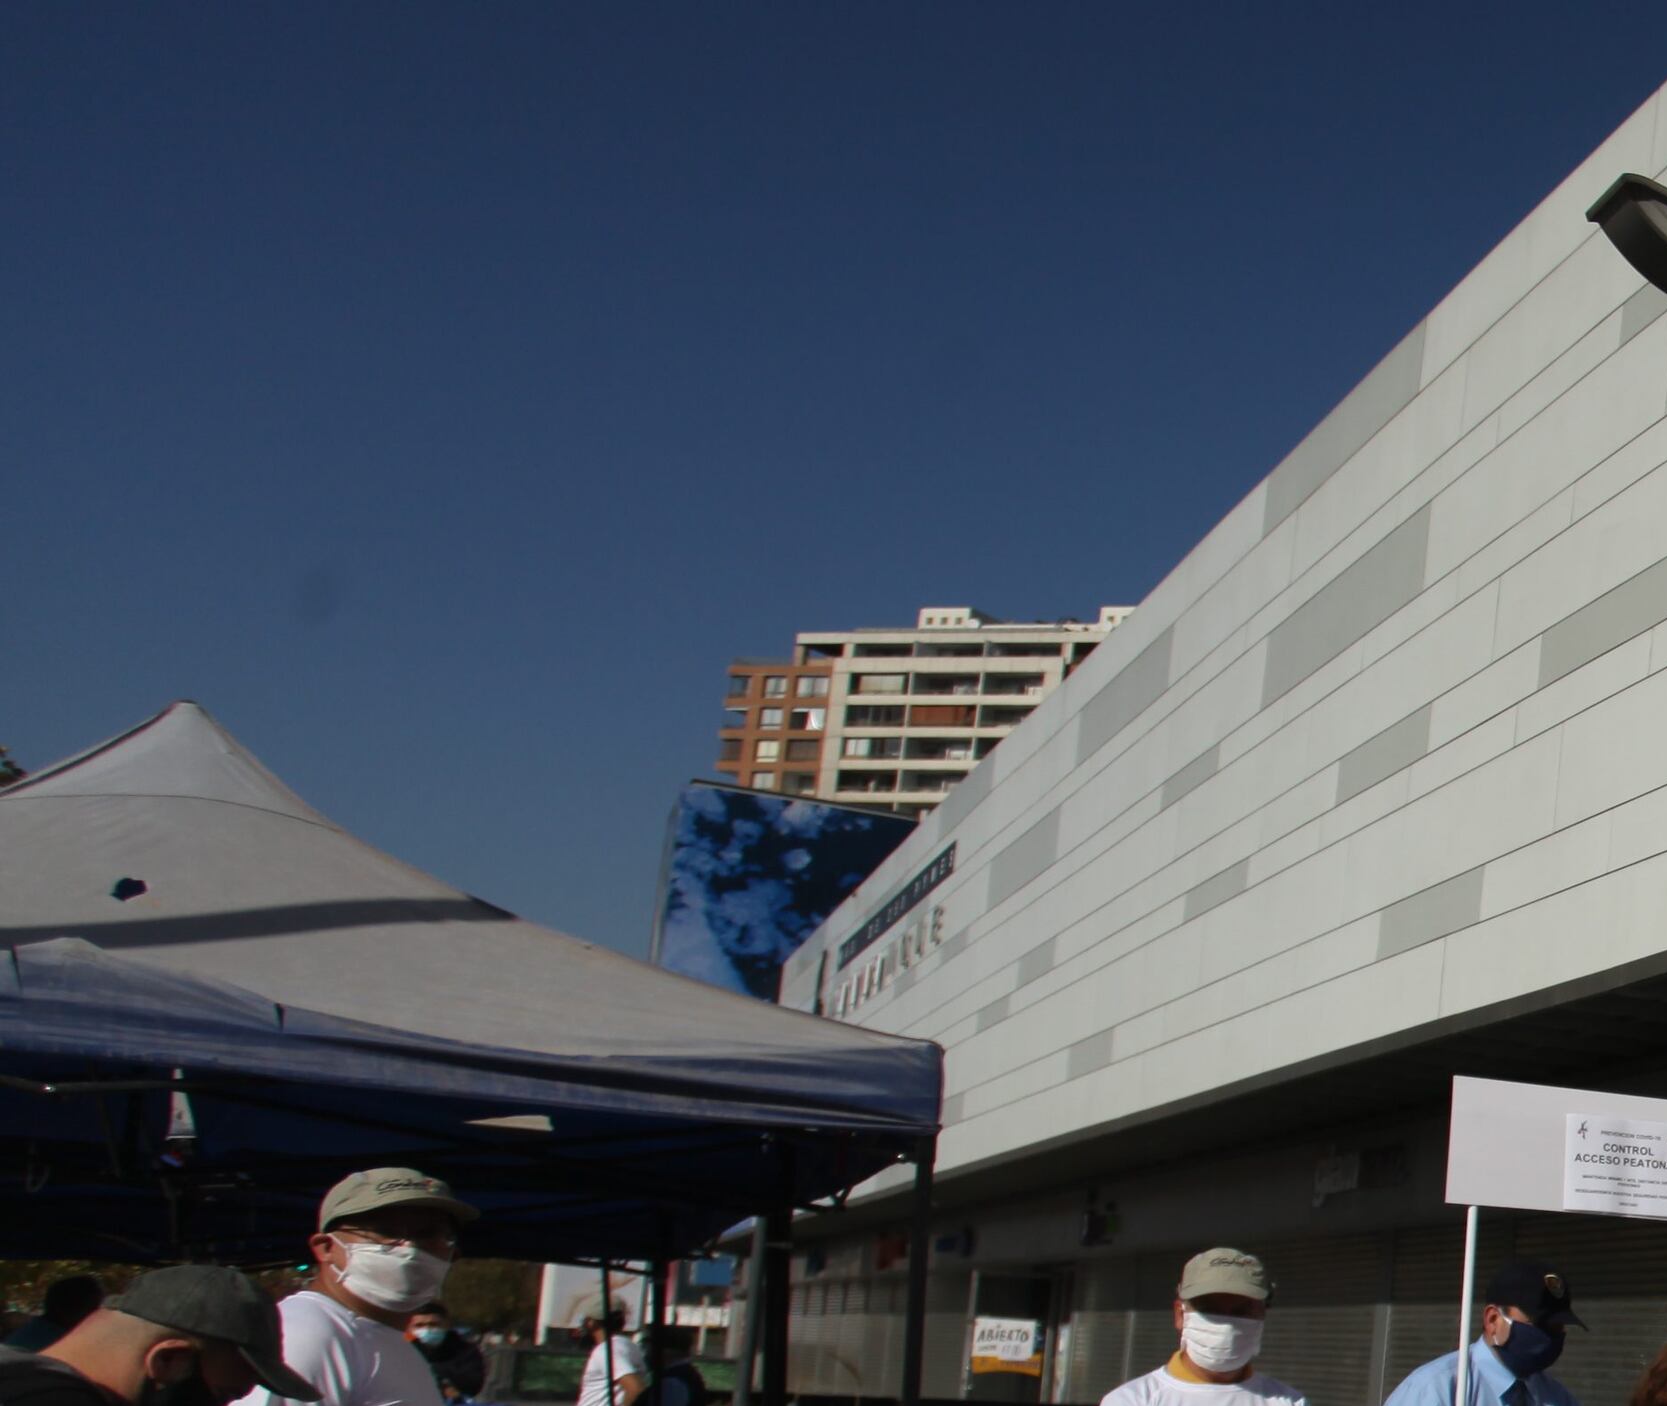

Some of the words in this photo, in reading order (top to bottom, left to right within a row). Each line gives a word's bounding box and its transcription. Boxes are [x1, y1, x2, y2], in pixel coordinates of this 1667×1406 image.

[1603, 1143, 1655, 1156] CONTROL
[1574, 1153, 1621, 1166] ACCESO
[977, 1324, 1029, 1343] ABIERTO
